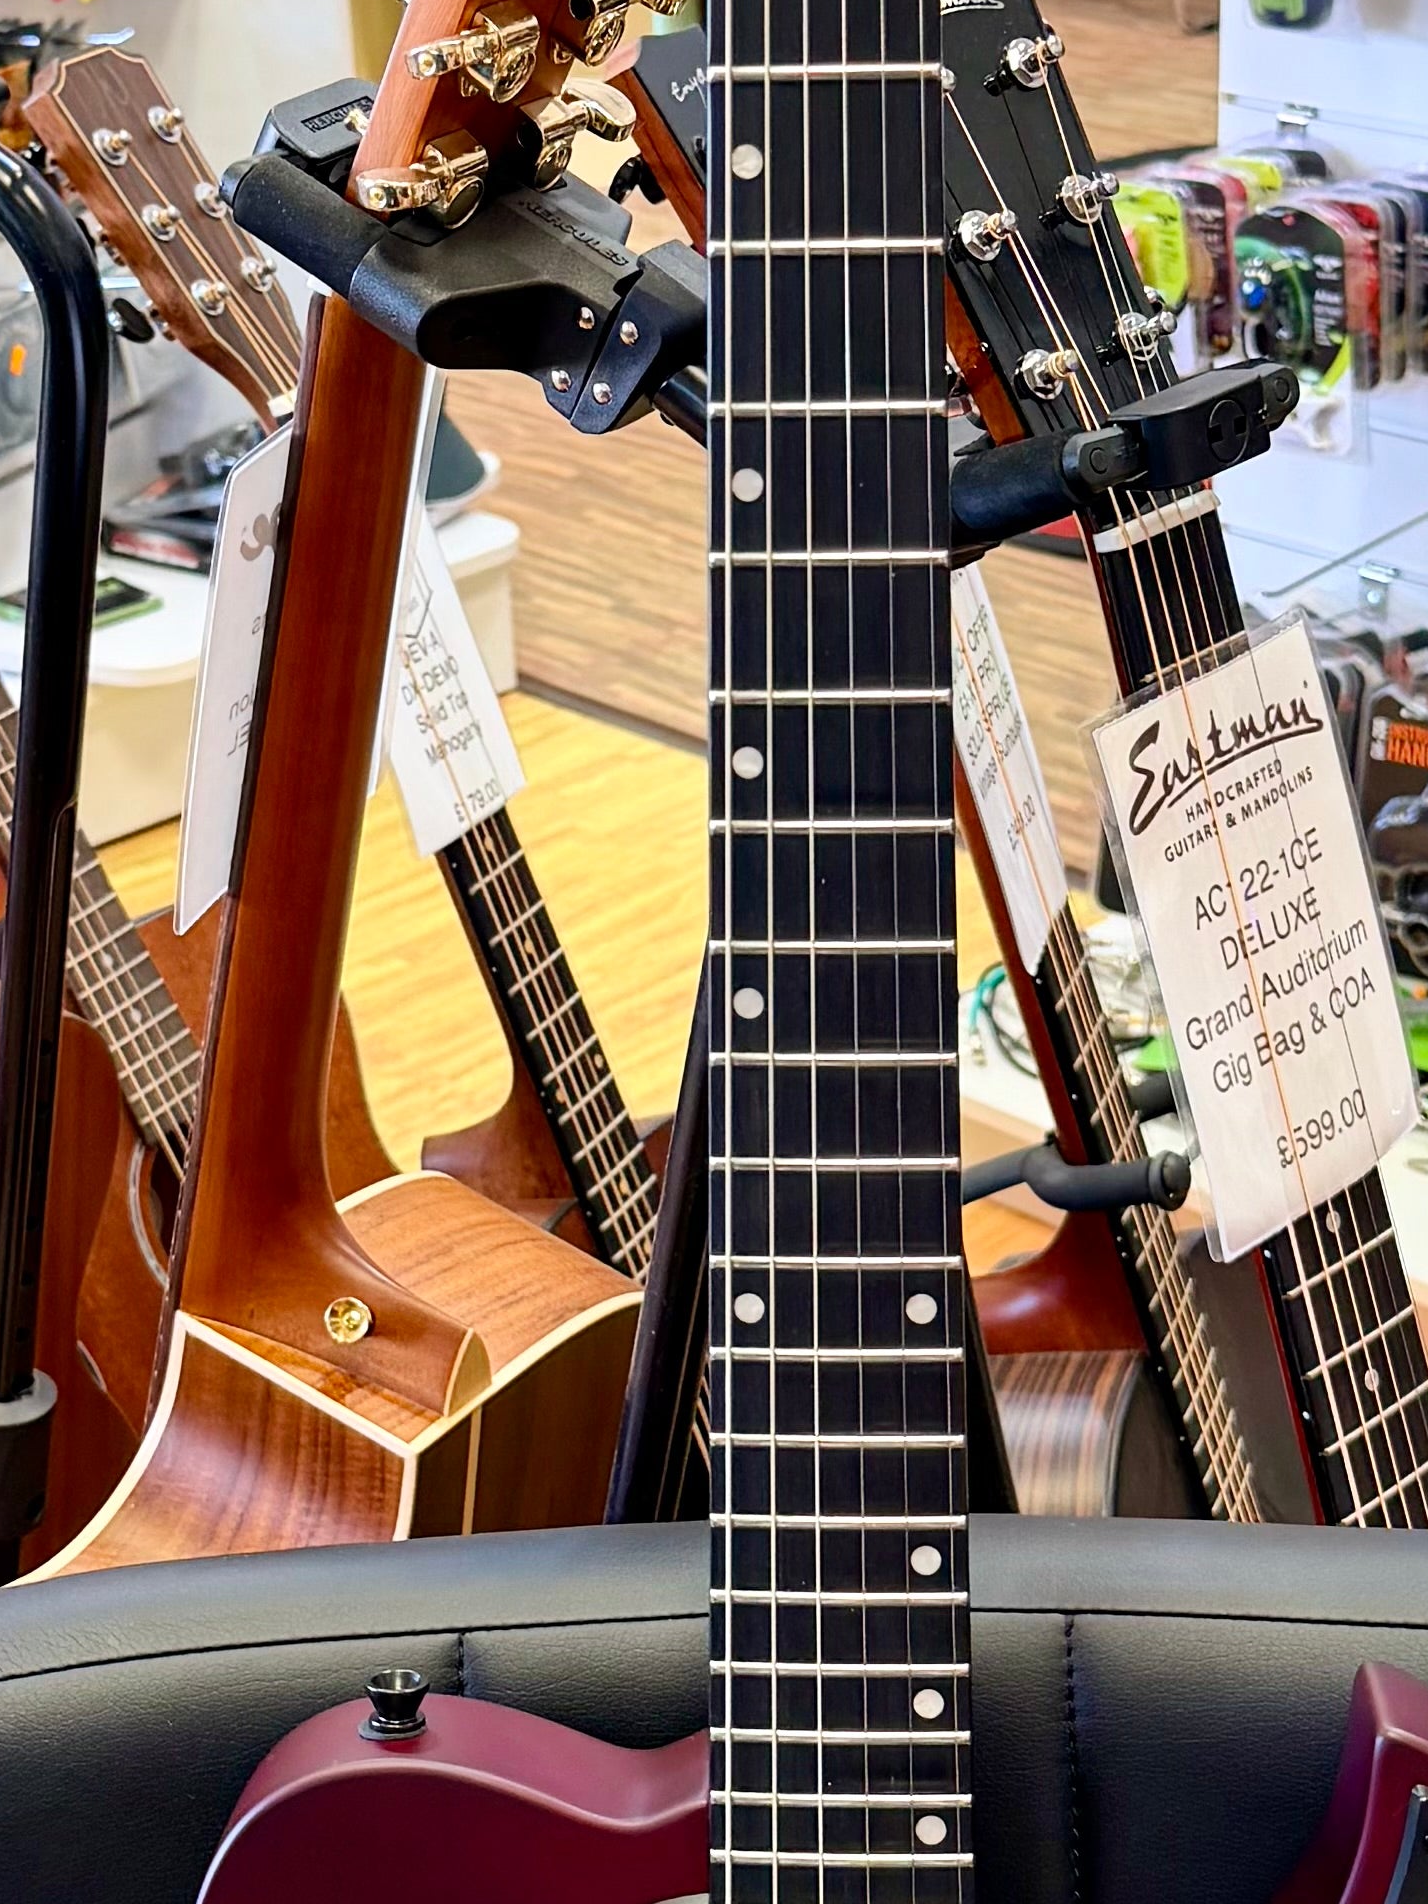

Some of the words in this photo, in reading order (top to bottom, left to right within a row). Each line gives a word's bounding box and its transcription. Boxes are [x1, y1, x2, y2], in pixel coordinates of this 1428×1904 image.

[1128, 696, 1323, 836] Eastman
[1184, 758, 1283, 824] HANDCRAFTED
[1225, 812, 1237, 829] &
[1240, 765, 1314, 823] MANDOLINS
[1194, 827, 1323, 931] AC22-1CE
[1219, 886, 1321, 971] DELUXE
[1185, 983, 1255, 1051] Grand
[1261, 918, 1369, 1008] Auditorium
[1213, 1050, 1253, 1094] Gig
[1253, 1019, 1306, 1067] Bag
[1309, 1001, 1328, 1035] &
[1328, 966, 1375, 1019] COA
[1276, 1087, 1368, 1169] £599.00
